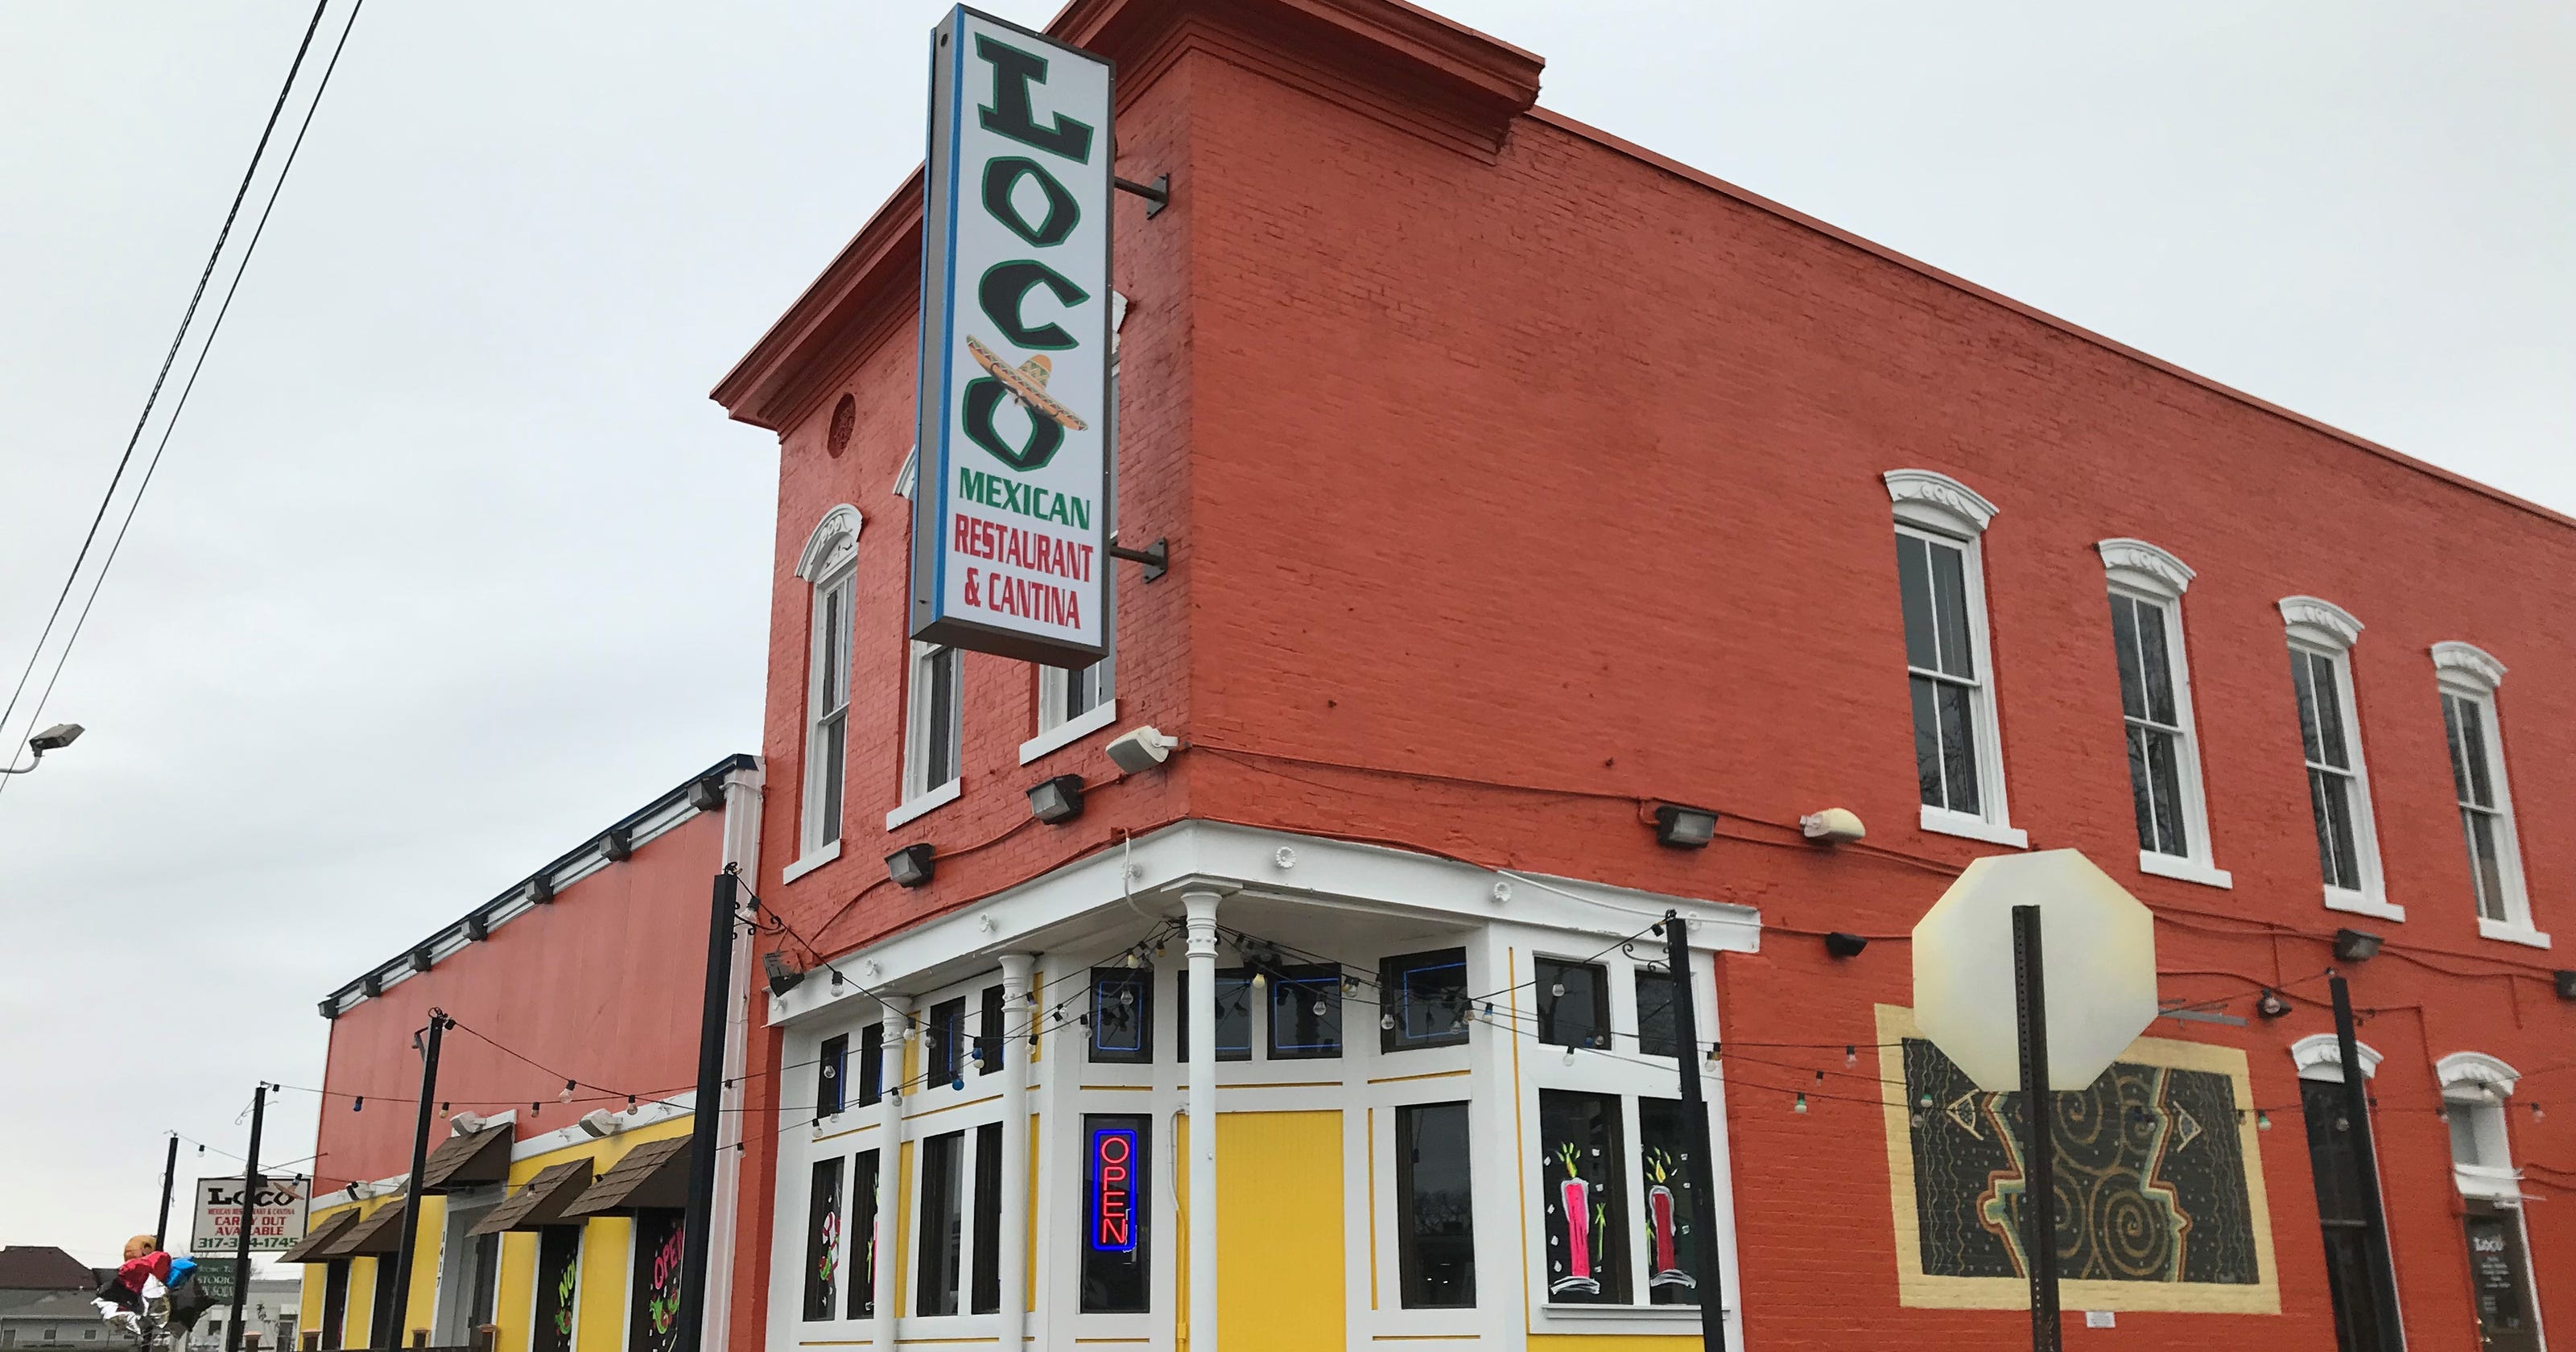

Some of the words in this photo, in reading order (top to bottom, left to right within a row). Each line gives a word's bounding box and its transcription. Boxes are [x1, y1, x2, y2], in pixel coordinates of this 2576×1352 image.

[962, 32, 1094, 472] LOCO
[959, 467, 1091, 530] MEXICAN
[954, 513, 1093, 583] RESTAURANT
[964, 567, 981, 608] &
[989, 572, 1081, 630] CANTINA
[215, 1216, 258, 1226] CARY
[261, 1216, 286, 1226] OUT
[1100, 1136, 1129, 1244] OPEN
[197, 1237, 299, 1248] 317-34-1745
[215, 1226, 283, 1236] AVAABLE
